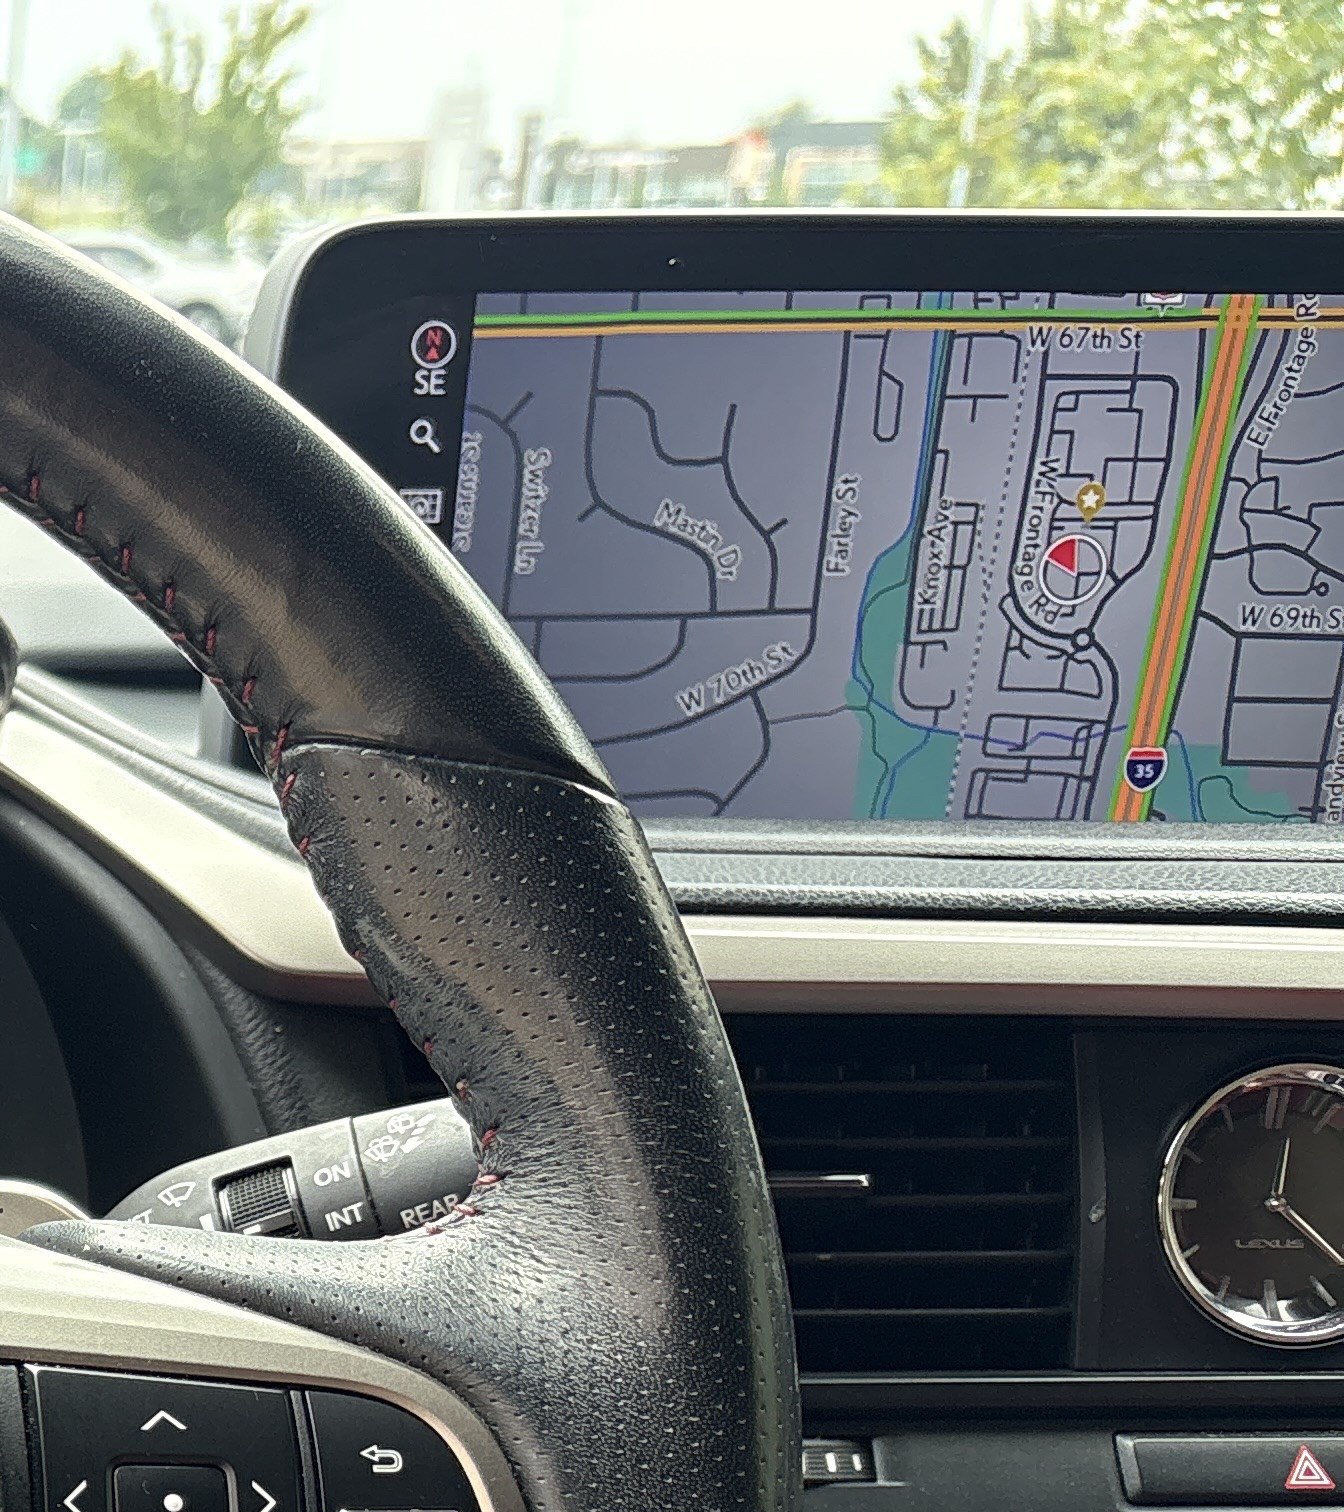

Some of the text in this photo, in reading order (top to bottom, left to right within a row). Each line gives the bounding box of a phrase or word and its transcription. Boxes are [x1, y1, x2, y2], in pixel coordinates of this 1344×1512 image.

[426, 329, 443, 348] N
[1029, 326, 1144, 348] W 67th St
[414, 368, 447, 396] SE
[826, 476, 859, 573] Farley St
[716, 548, 740, 578] Dr
[917, 499, 954, 606] Knox Ave
[1028, 593, 1061, 626] Rd
[1241, 604, 1344, 629] W 69th S
[679, 643, 794, 712] W 70th St
[1134, 763, 1155, 779] 35
[313, 1160, 352, 1188] ON
[325, 1201, 366, 1232] INT
[400, 1193, 459, 1230] REAR
